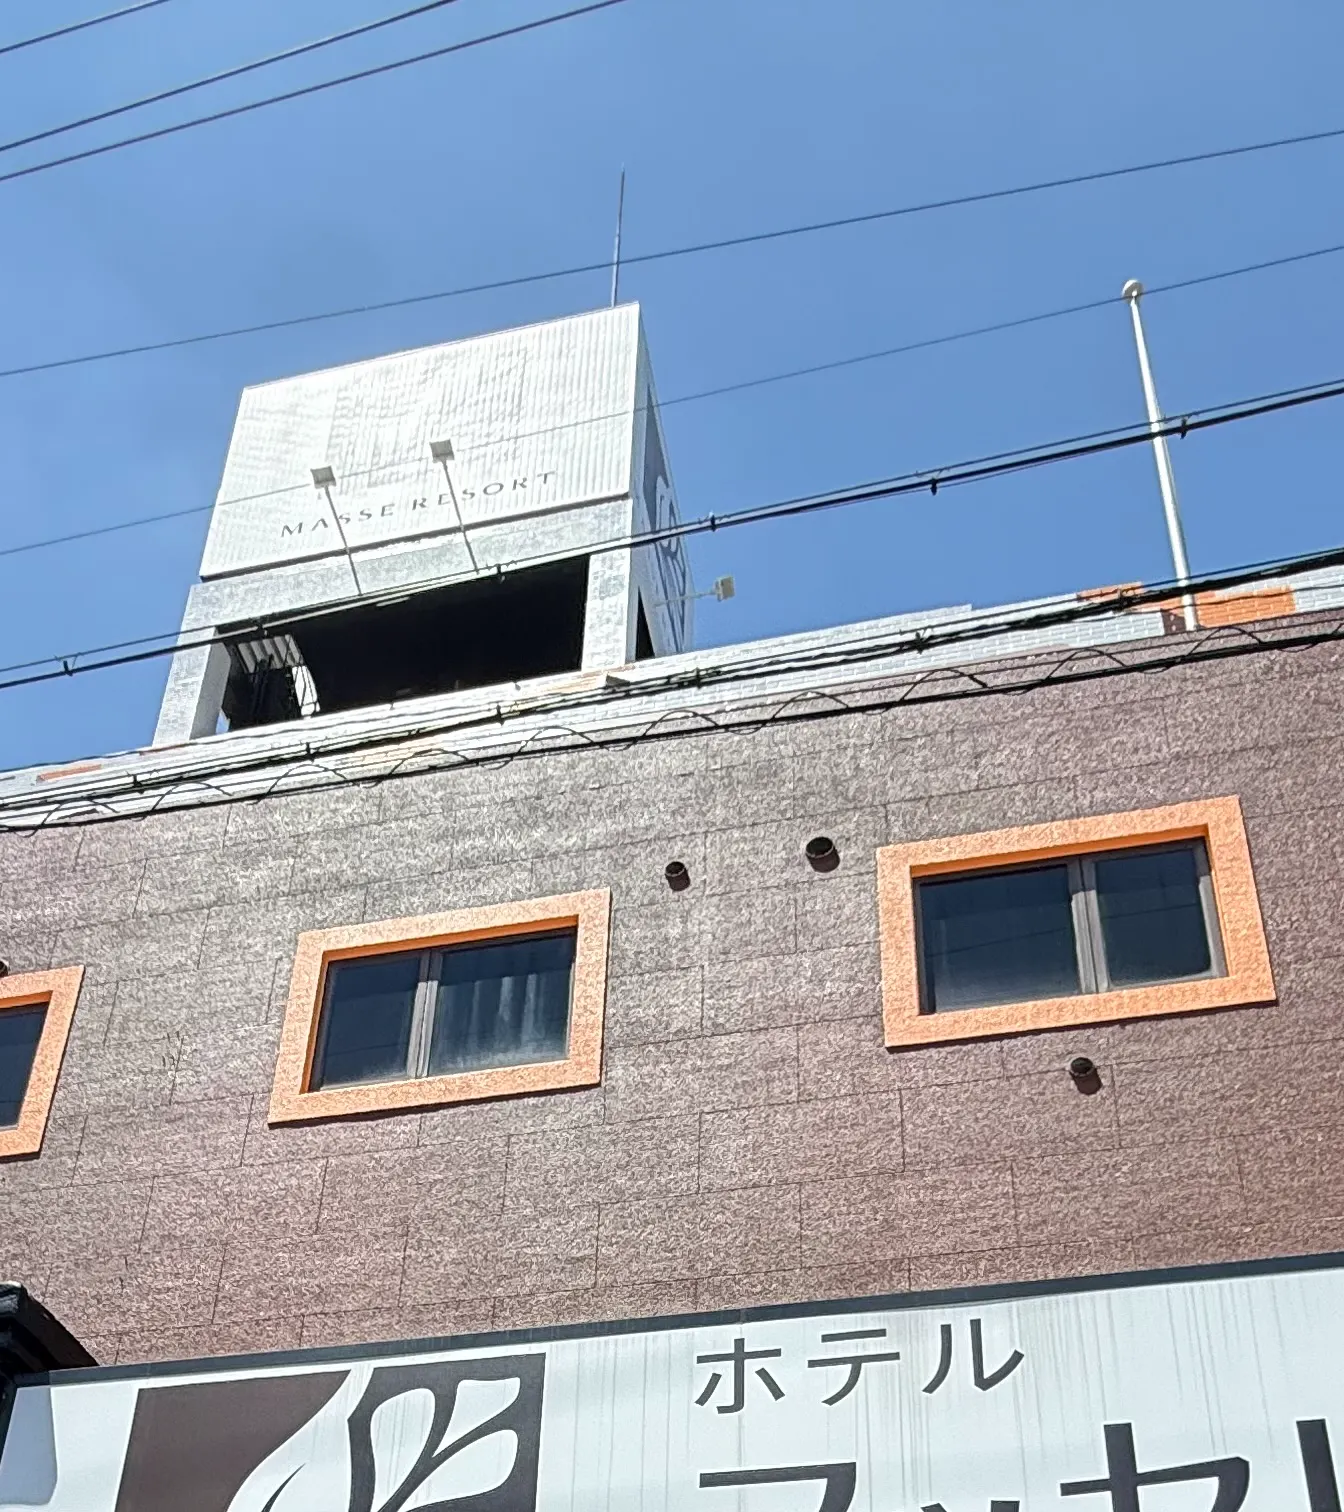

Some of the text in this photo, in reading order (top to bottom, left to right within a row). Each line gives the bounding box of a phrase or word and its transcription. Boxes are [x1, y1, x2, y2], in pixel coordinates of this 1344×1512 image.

[280, 470, 556, 538] MASSE RESORT
[694, 1317, 1025, 1414] ホテル
